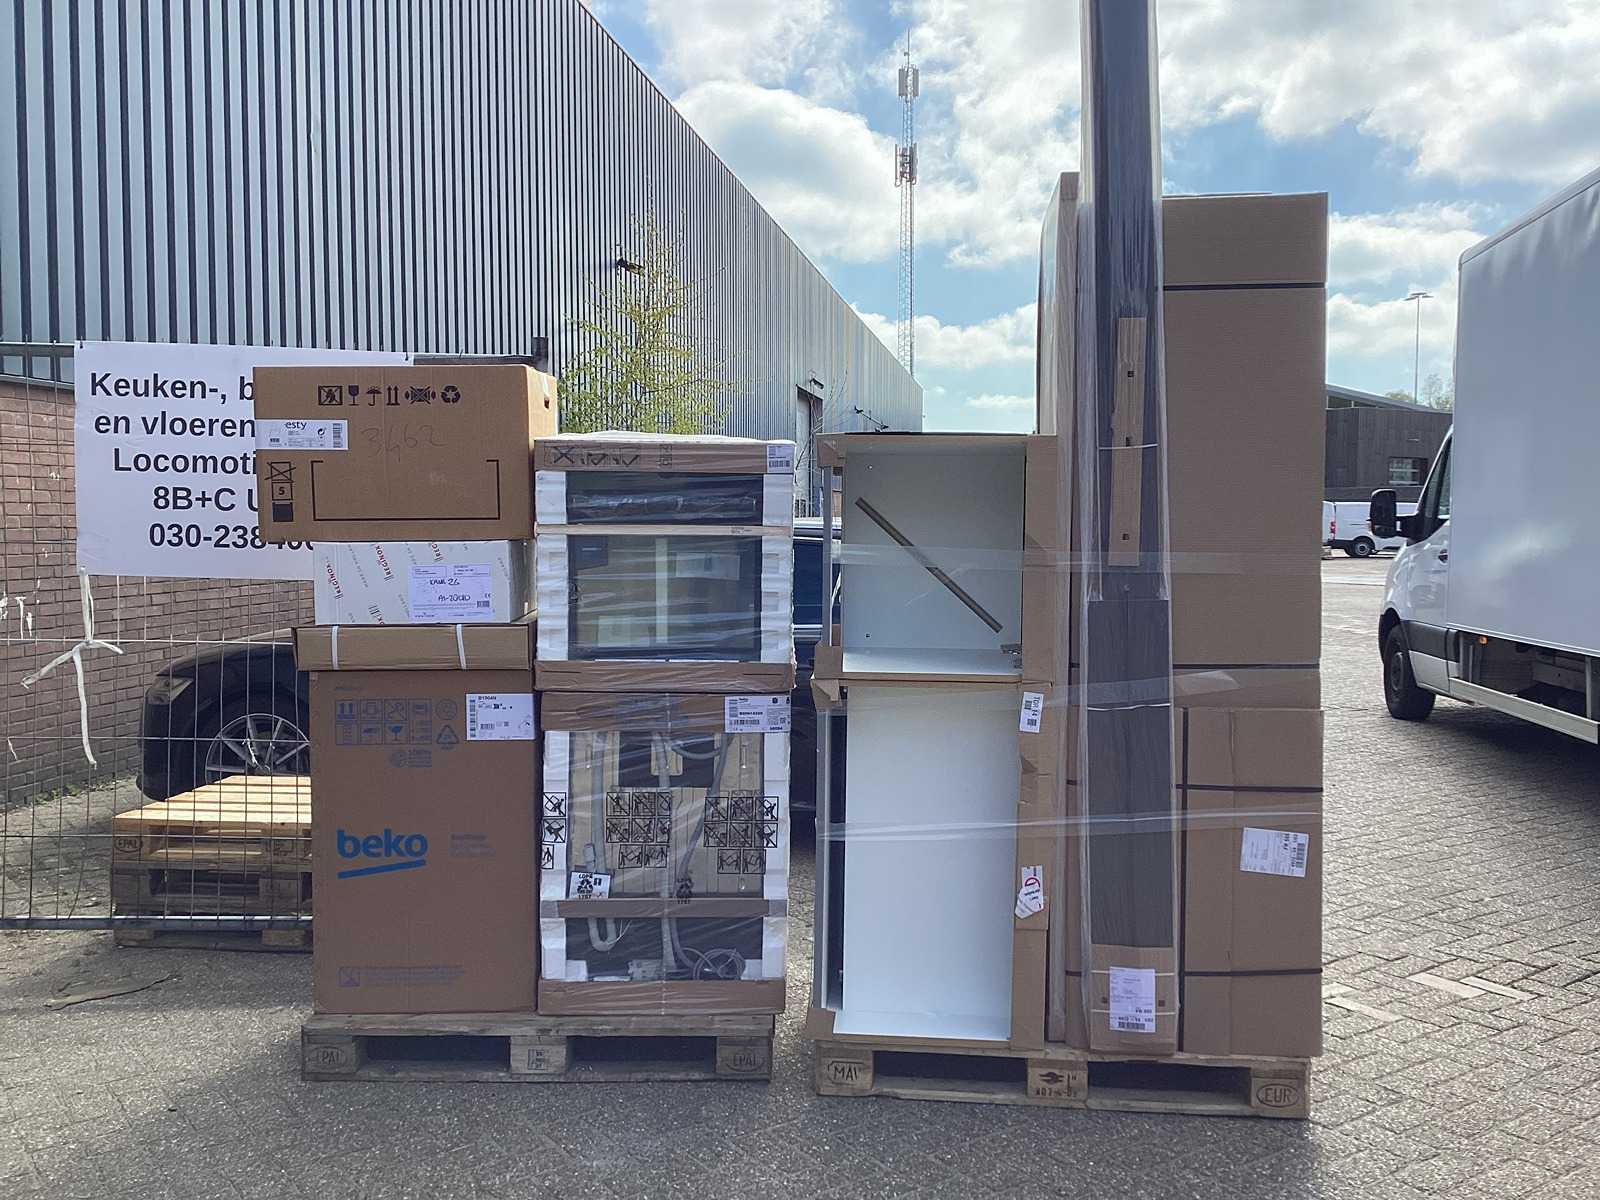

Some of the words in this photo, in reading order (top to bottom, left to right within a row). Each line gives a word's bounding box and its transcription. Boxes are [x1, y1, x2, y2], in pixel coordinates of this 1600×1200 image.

[91, 372, 226, 404] Keuken-,
[94, 414, 130, 434] en
[141, 410, 256, 437] vloeren
[153, 486, 236, 511] 8B+C
[336, 828, 428, 859] beko
